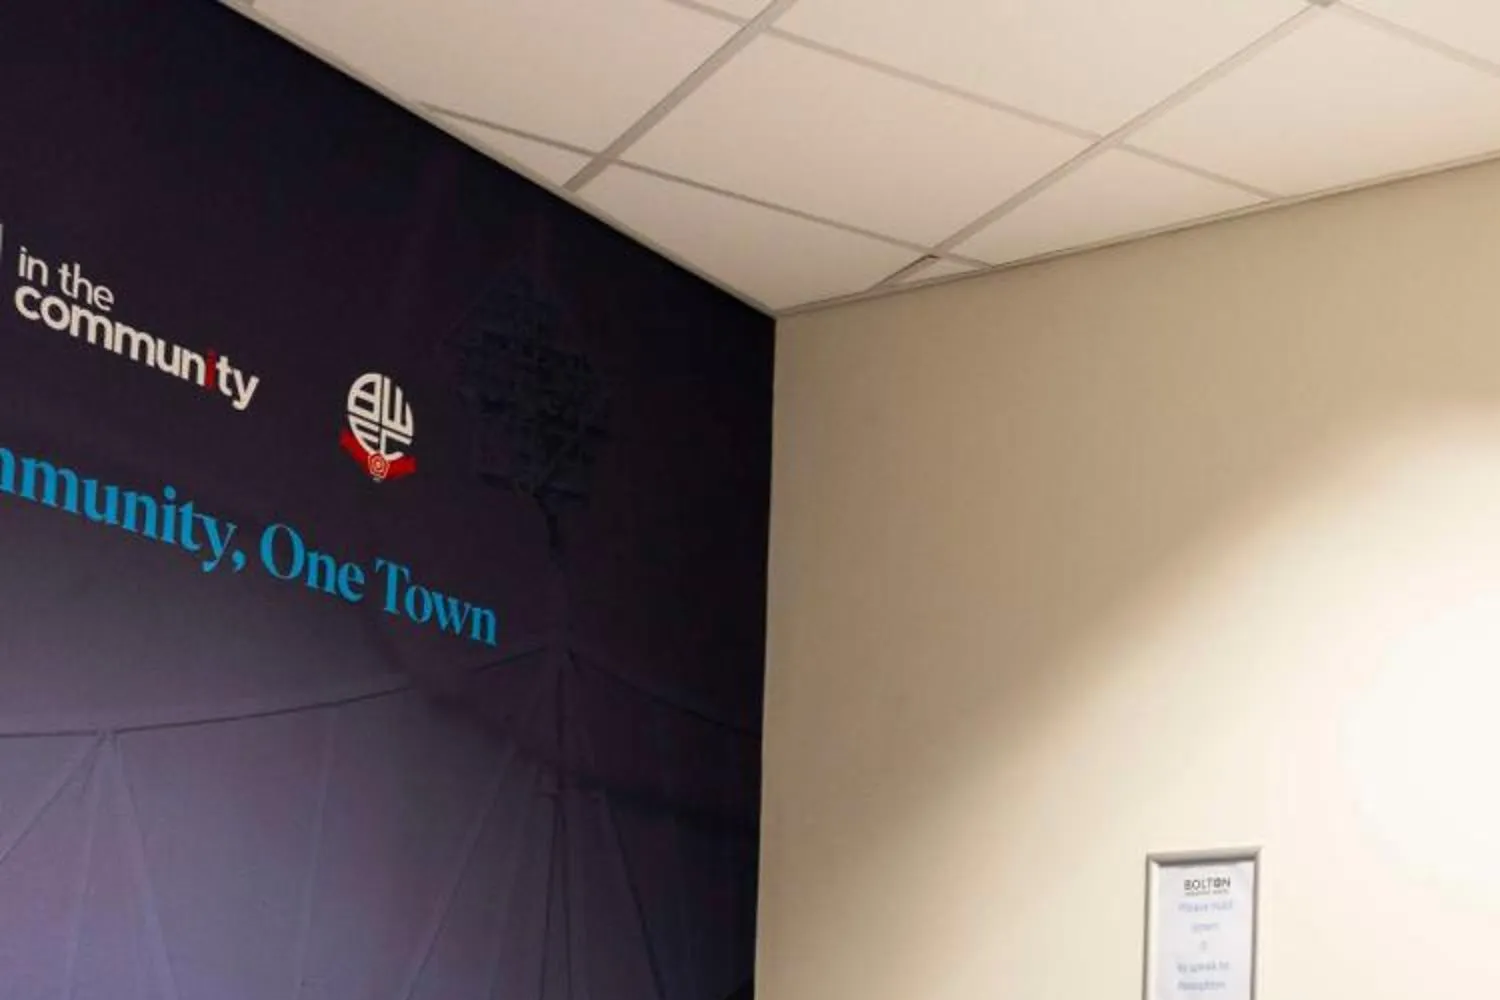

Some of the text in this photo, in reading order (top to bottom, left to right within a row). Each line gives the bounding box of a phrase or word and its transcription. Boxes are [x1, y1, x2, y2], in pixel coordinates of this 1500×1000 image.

[18, 246, 115, 311] in the
[14, 285, 260, 411] community
[260, 522, 365, 602] One
[376, 558, 498, 646] Town
